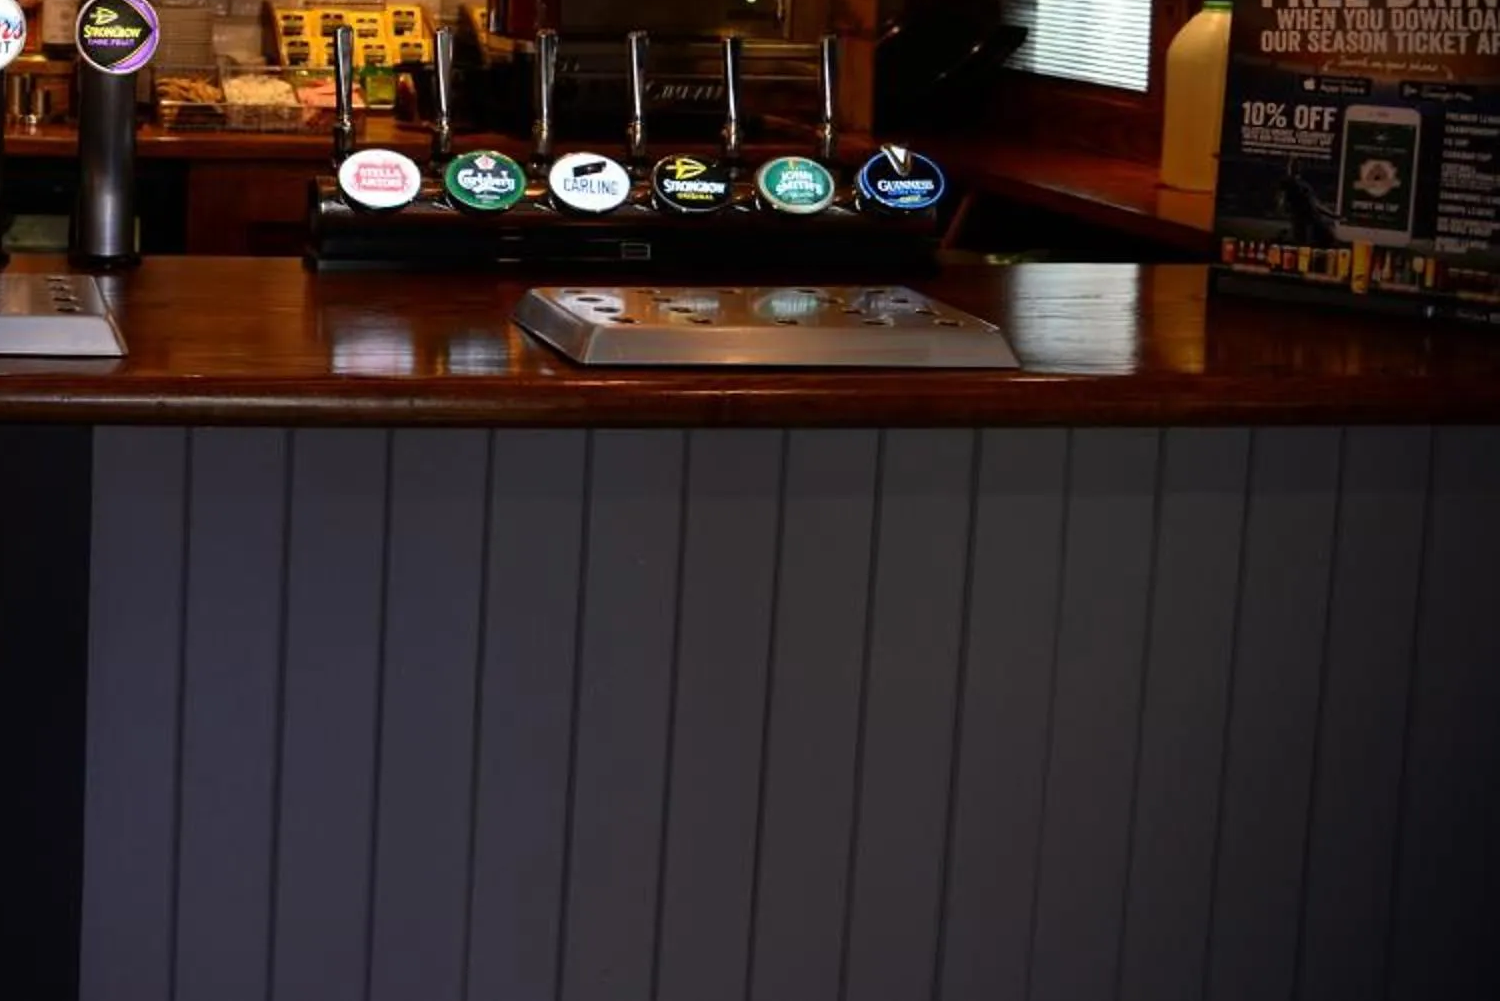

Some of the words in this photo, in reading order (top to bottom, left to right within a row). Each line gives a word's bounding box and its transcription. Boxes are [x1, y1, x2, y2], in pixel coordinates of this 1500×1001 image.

[1276, 8, 1337, 30] WHEN
[1343, 9, 1384, 30] YOU
[1390, 8, 1500, 32] DOWNLOA
[1260, 30, 1301, 52] OUR
[1307, 30, 1387, 53] SEASON
[1394, 31, 1470, 54] TICKET
[1242, 101, 1287, 127] 10%
[1294, 104, 1338, 131] OFF
[563, 179, 618, 196] CARLING
